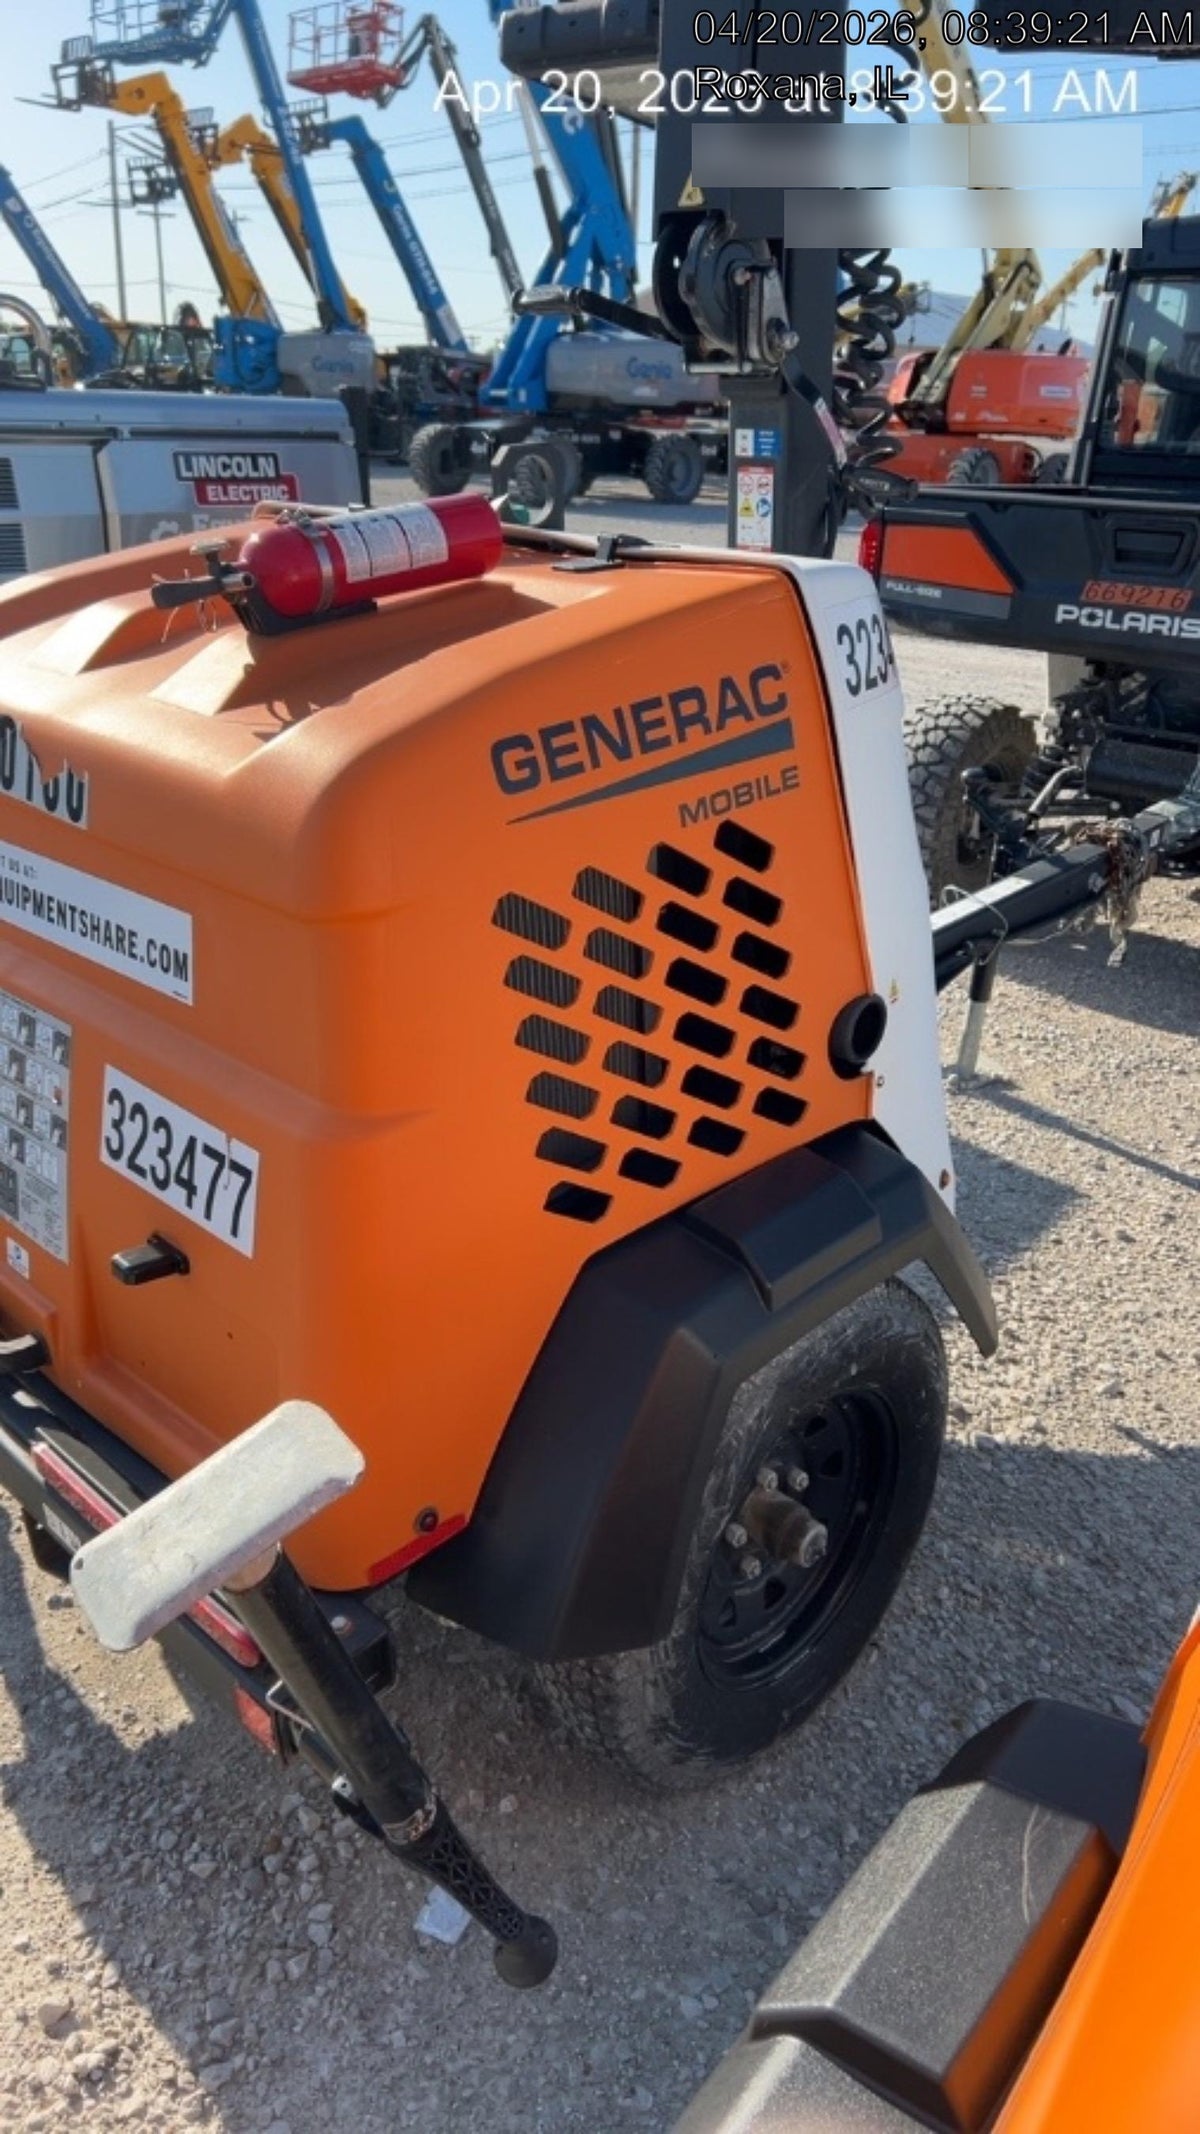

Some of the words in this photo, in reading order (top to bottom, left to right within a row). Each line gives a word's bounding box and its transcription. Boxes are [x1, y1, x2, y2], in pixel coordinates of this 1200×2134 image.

[626, 356, 673, 379] Genie
[177, 454, 277, 480] LINCOLN
[206, 483, 290, 502] ELECTRIC
[1085, 582, 1186, 610] 669216
[1055, 603, 1200, 638] POLARIS
[490, 662, 789, 796] GENERAC
[678, 765, 800, 829] MOBILE
[105, 1087, 253, 1239] 323477
